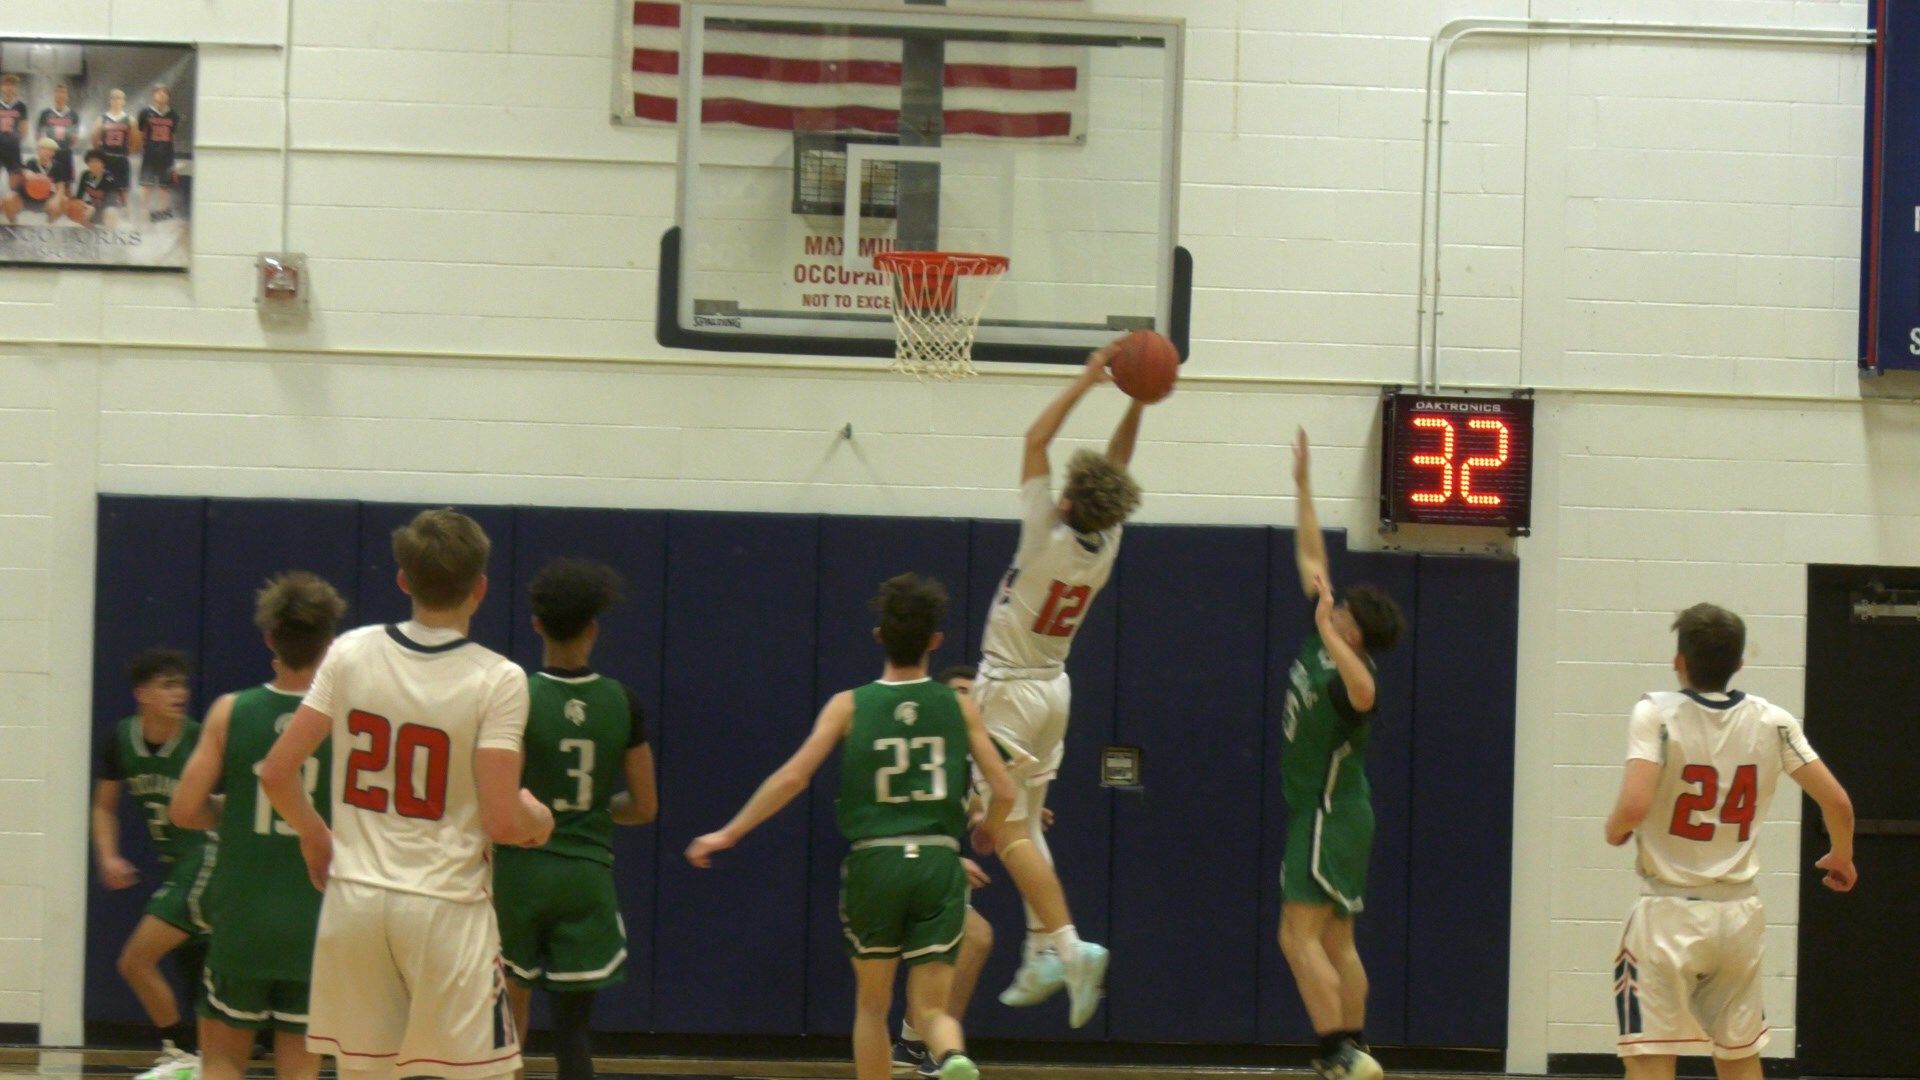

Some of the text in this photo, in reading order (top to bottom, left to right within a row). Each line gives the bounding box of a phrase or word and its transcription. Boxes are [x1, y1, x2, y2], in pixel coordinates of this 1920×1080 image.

[804, 236, 896, 257] MAXMU
[802, 294, 828, 307] NOT
[834, 295, 852, 308] TO
[1411, 417, 1509, 505] 32
[1031, 579, 1092, 637] 12
[343, 708, 451, 822] 20
[553, 738, 595, 812] 3
[873, 736, 948, 803] 23
[1668, 764, 1758, 843] 24
